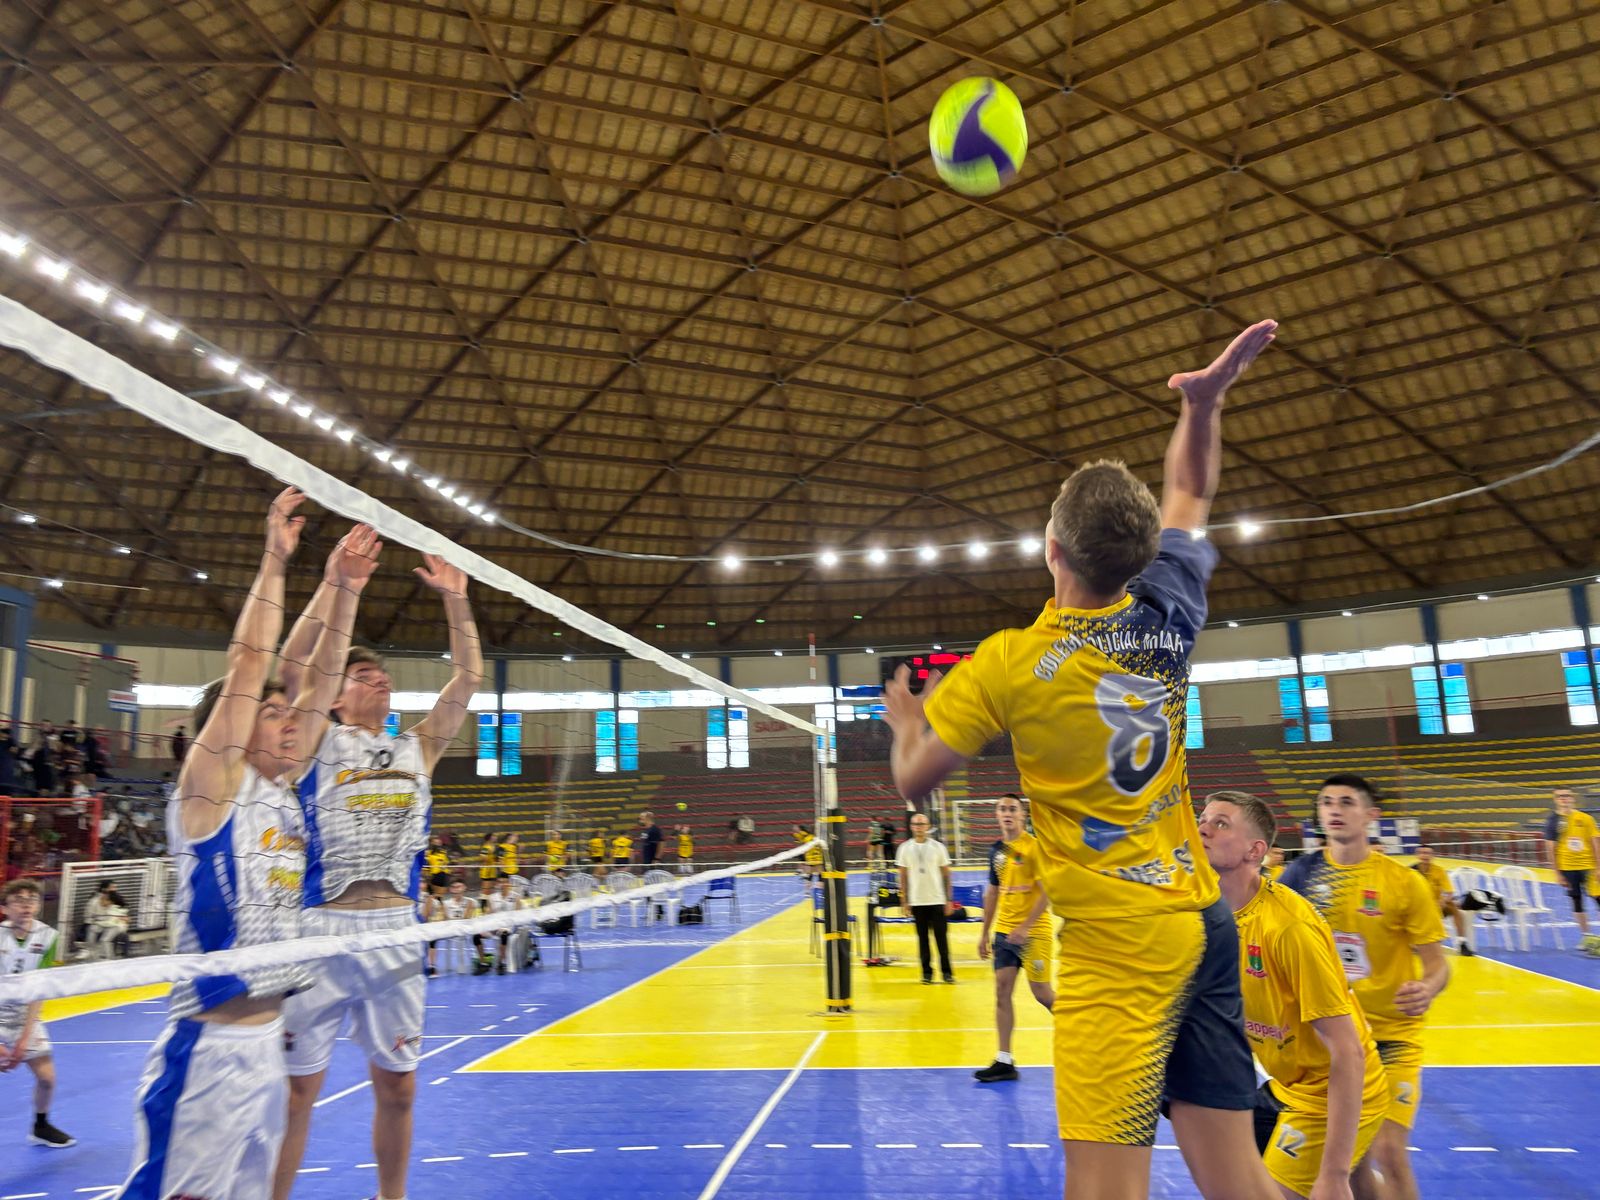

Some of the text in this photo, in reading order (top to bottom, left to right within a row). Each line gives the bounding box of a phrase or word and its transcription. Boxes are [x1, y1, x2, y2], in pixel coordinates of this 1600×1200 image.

[1094, 673, 1171, 797] 8
[1396, 1081, 1413, 1105] 2
[1276, 1123, 1306, 1159] 12
